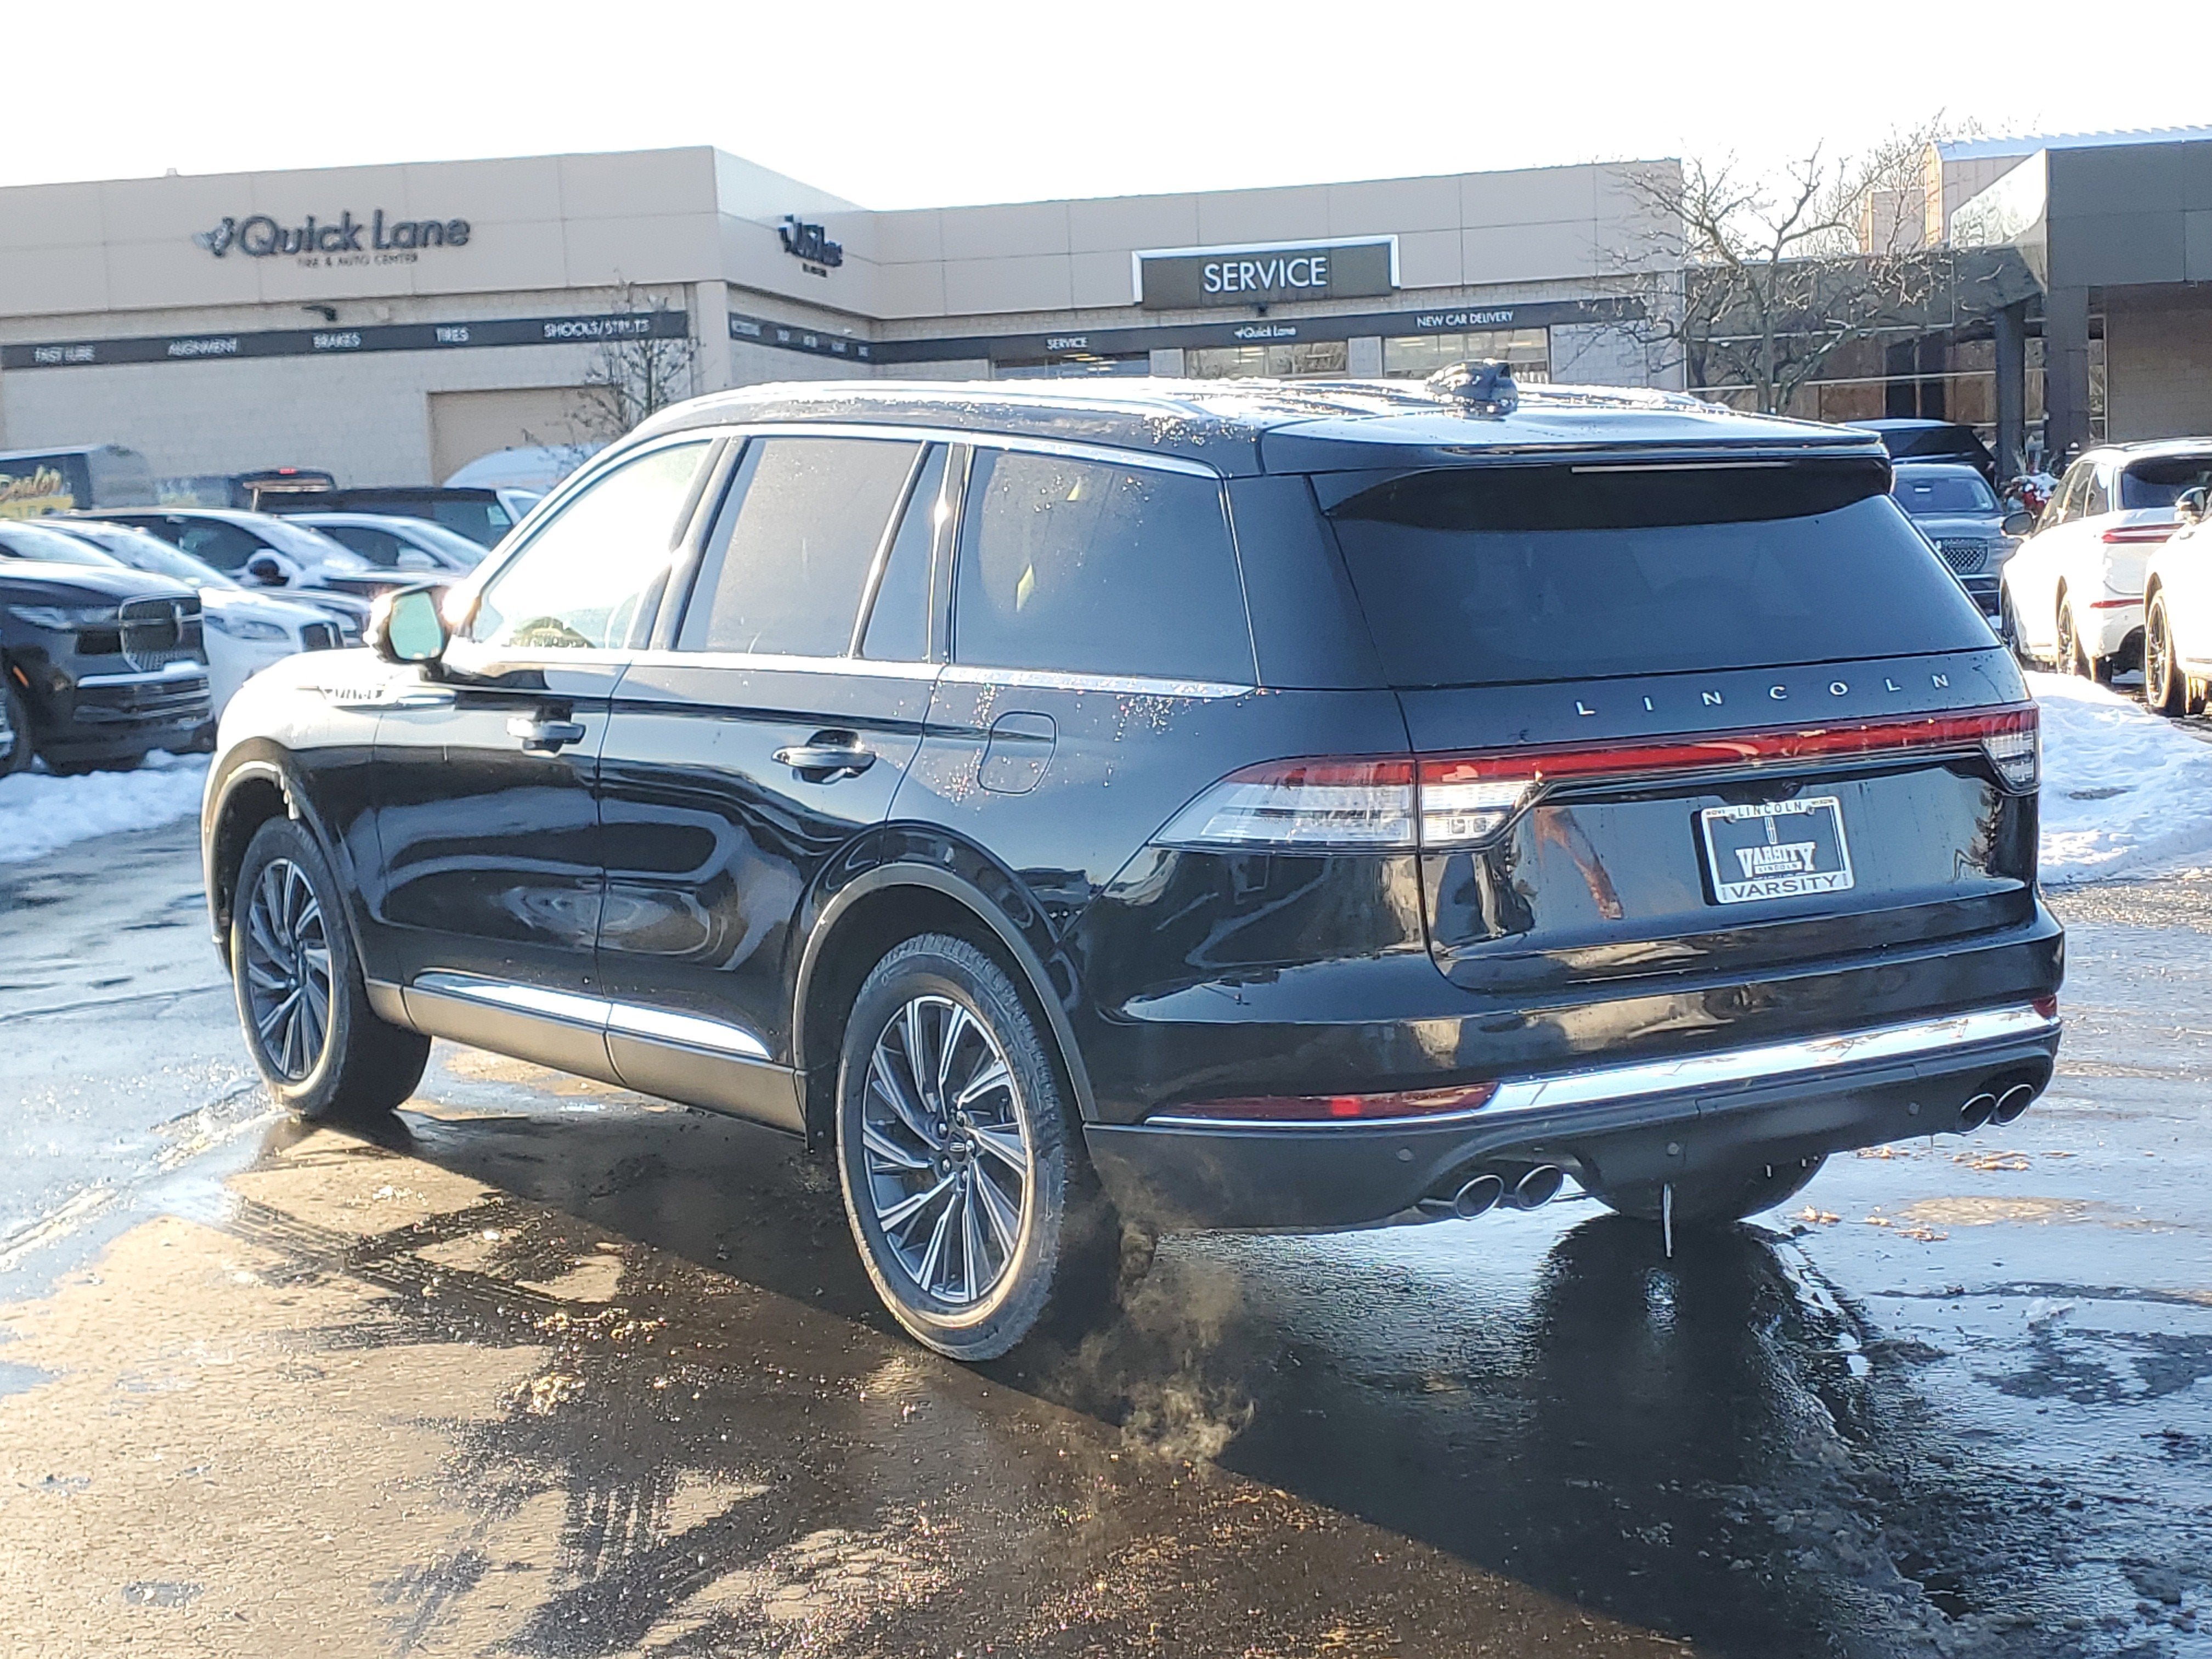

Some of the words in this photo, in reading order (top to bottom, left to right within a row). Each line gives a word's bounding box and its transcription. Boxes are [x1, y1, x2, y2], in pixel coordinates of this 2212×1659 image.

[240, 211, 363, 257] Quick
[373, 209, 470, 250] Lane
[1204, 256, 1328, 293] SERVICE
[1417, 315, 1444, 328] NEW
[1445, 313, 1468, 326] CAR
[1469, 309, 1514, 325] DELIVERY
[1243, 325, 1272, 338] Quick
[1046, 337, 1088, 351] SERVICE
[1575, 673, 1949, 716] LINCOLN
[1737, 801, 1803, 817] LINCOLN
[1735, 842, 1817, 879] VARSITY
[1758, 863, 1798, 872] LINCOLN
[1730, 874, 1838, 899] VARSITY
